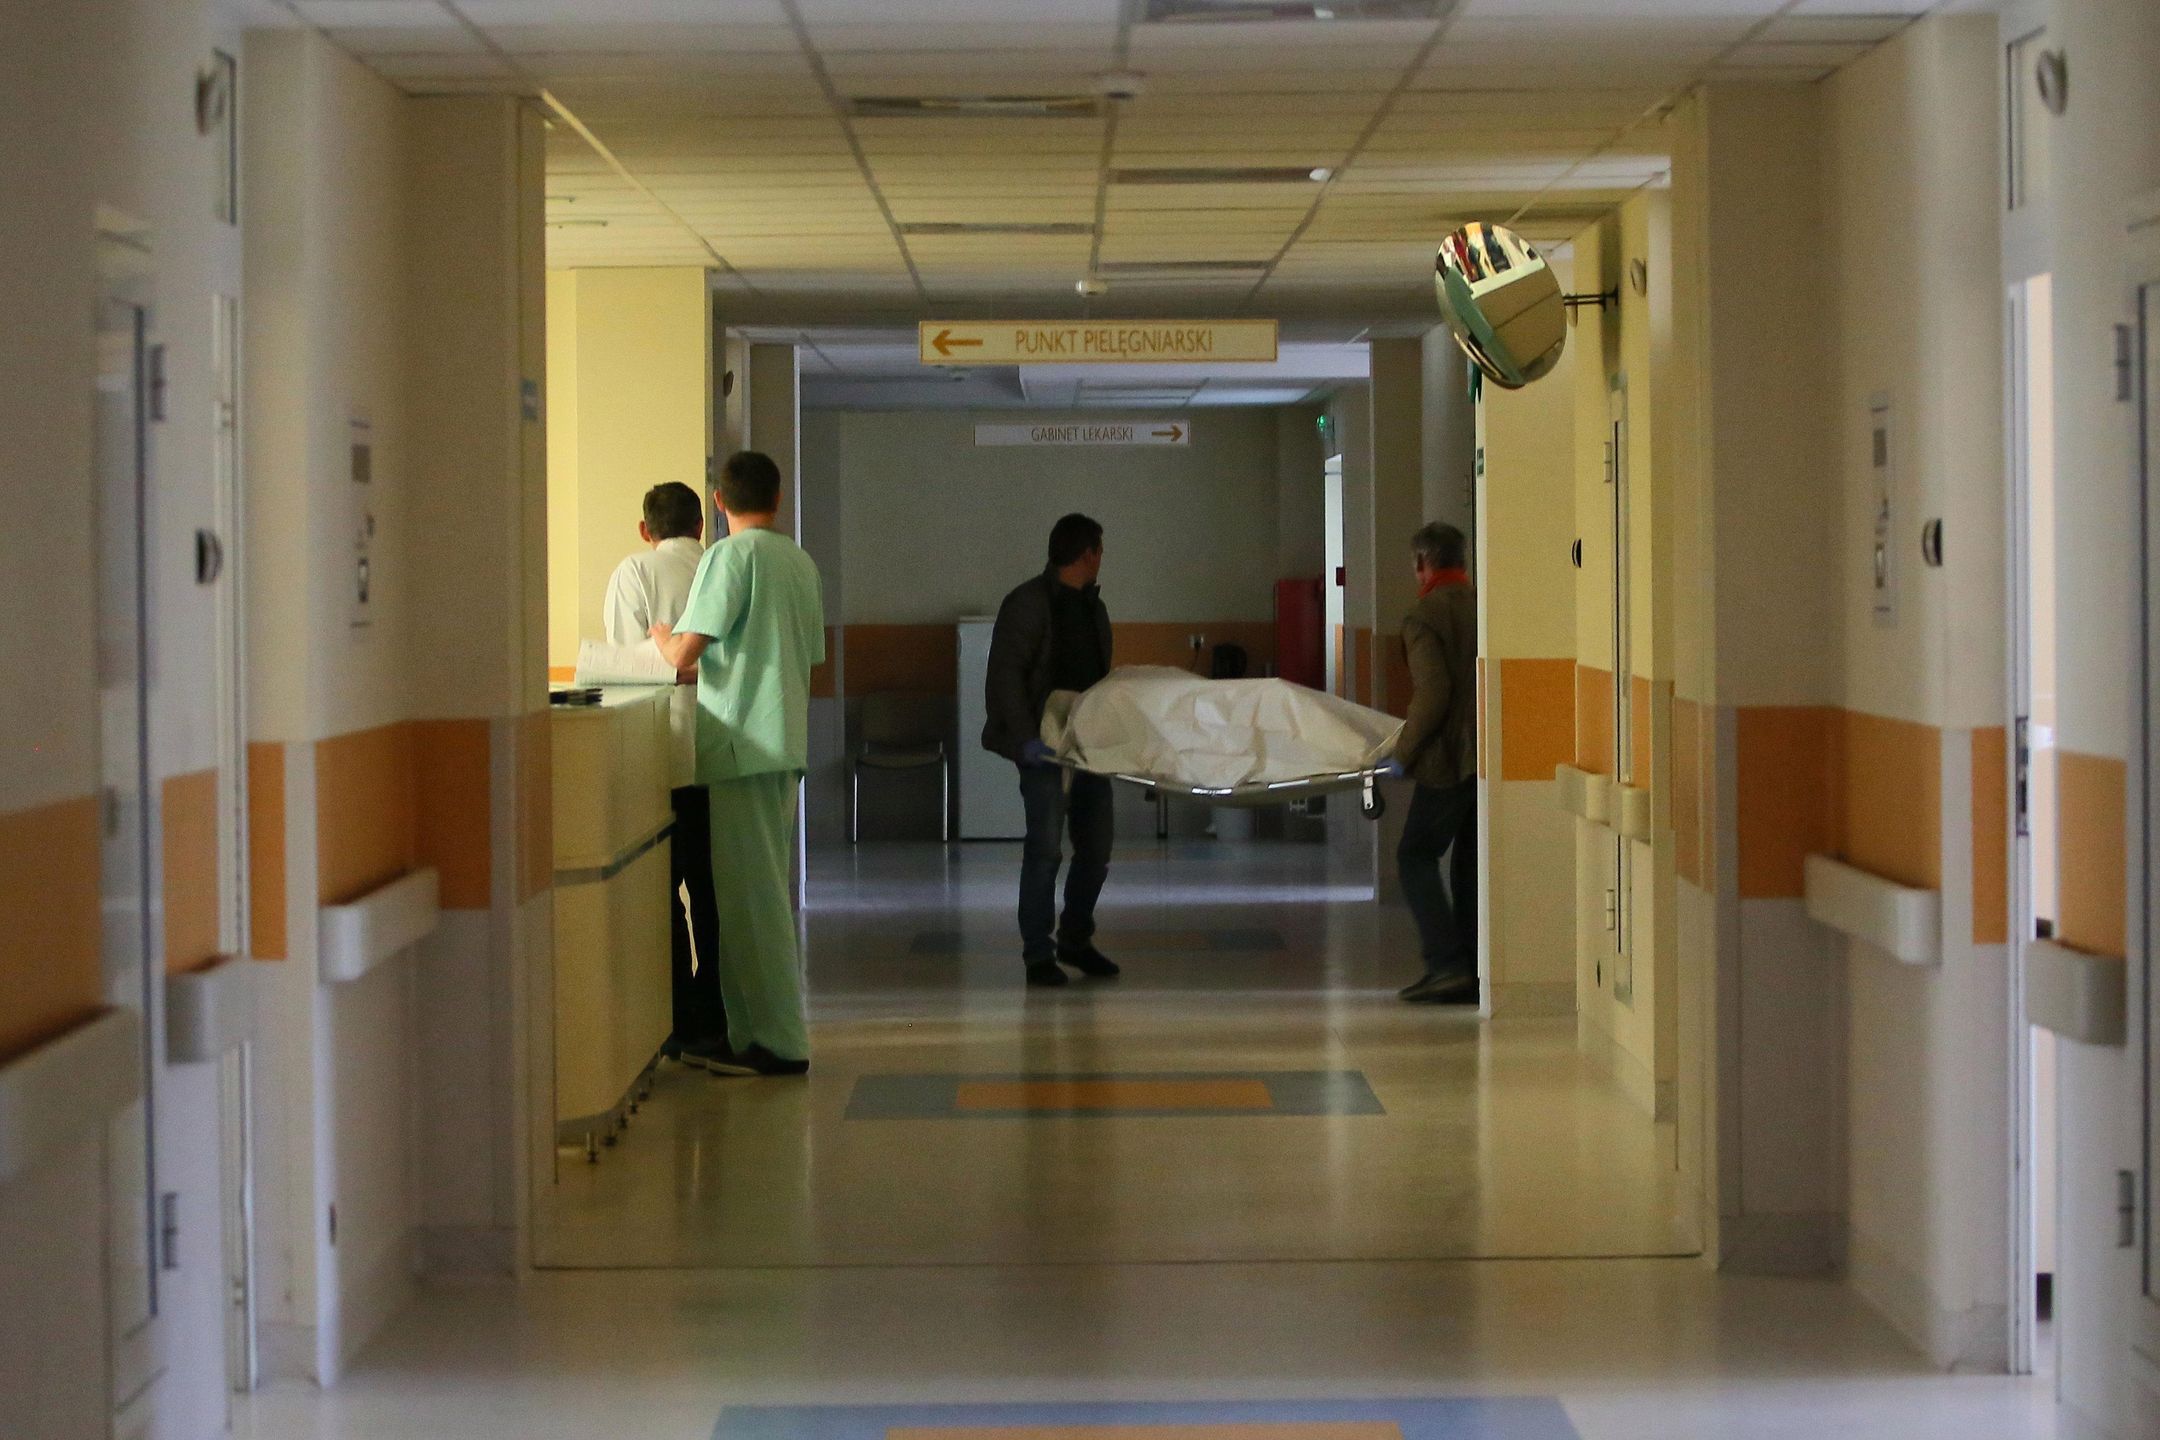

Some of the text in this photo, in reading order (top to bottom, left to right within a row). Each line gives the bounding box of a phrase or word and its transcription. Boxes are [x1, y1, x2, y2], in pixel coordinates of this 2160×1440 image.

[1015, 329, 1213, 358] PUNKT PIELĘGNIARSKI
[1031, 426, 1134, 442] GABINET LEKARSKI
